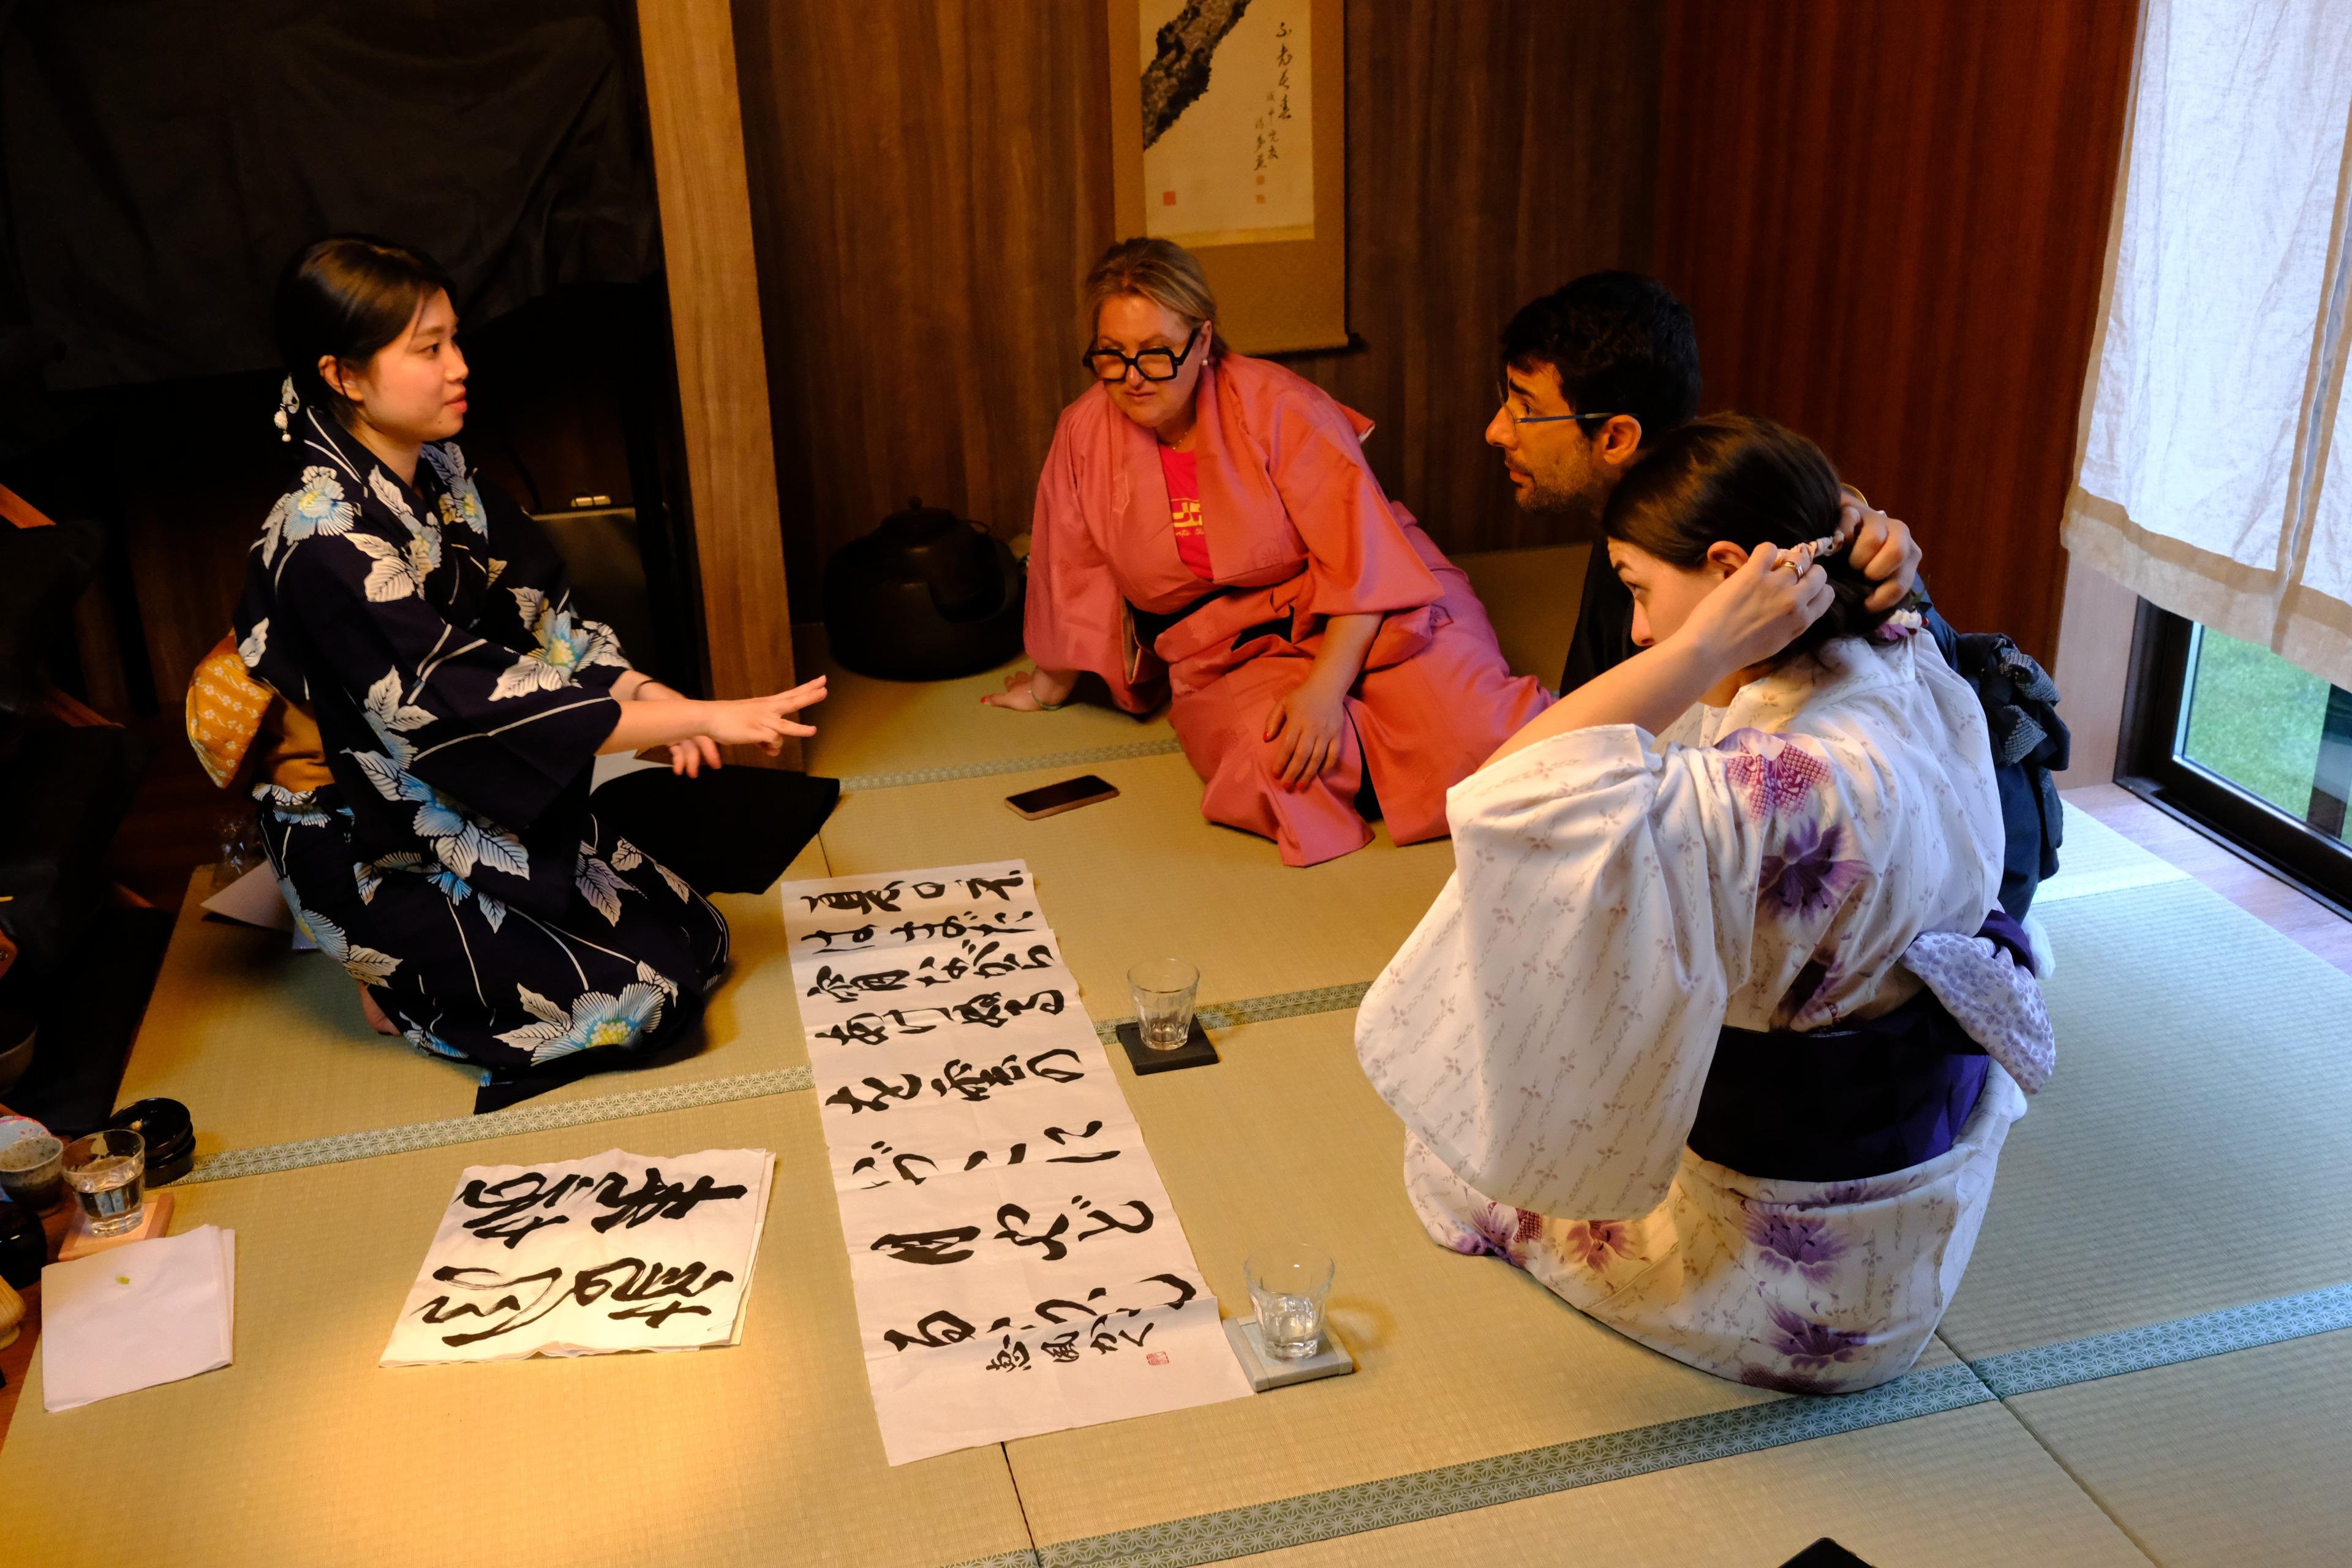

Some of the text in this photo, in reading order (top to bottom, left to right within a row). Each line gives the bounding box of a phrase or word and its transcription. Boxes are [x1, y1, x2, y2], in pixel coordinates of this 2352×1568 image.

[801, 911, 1035, 954] はまだ
[807, 940, 1054, 1003] 宵ながら
[826, 1049, 1085, 1114] を雲の
[870, 1195, 1154, 1265] 月やど
